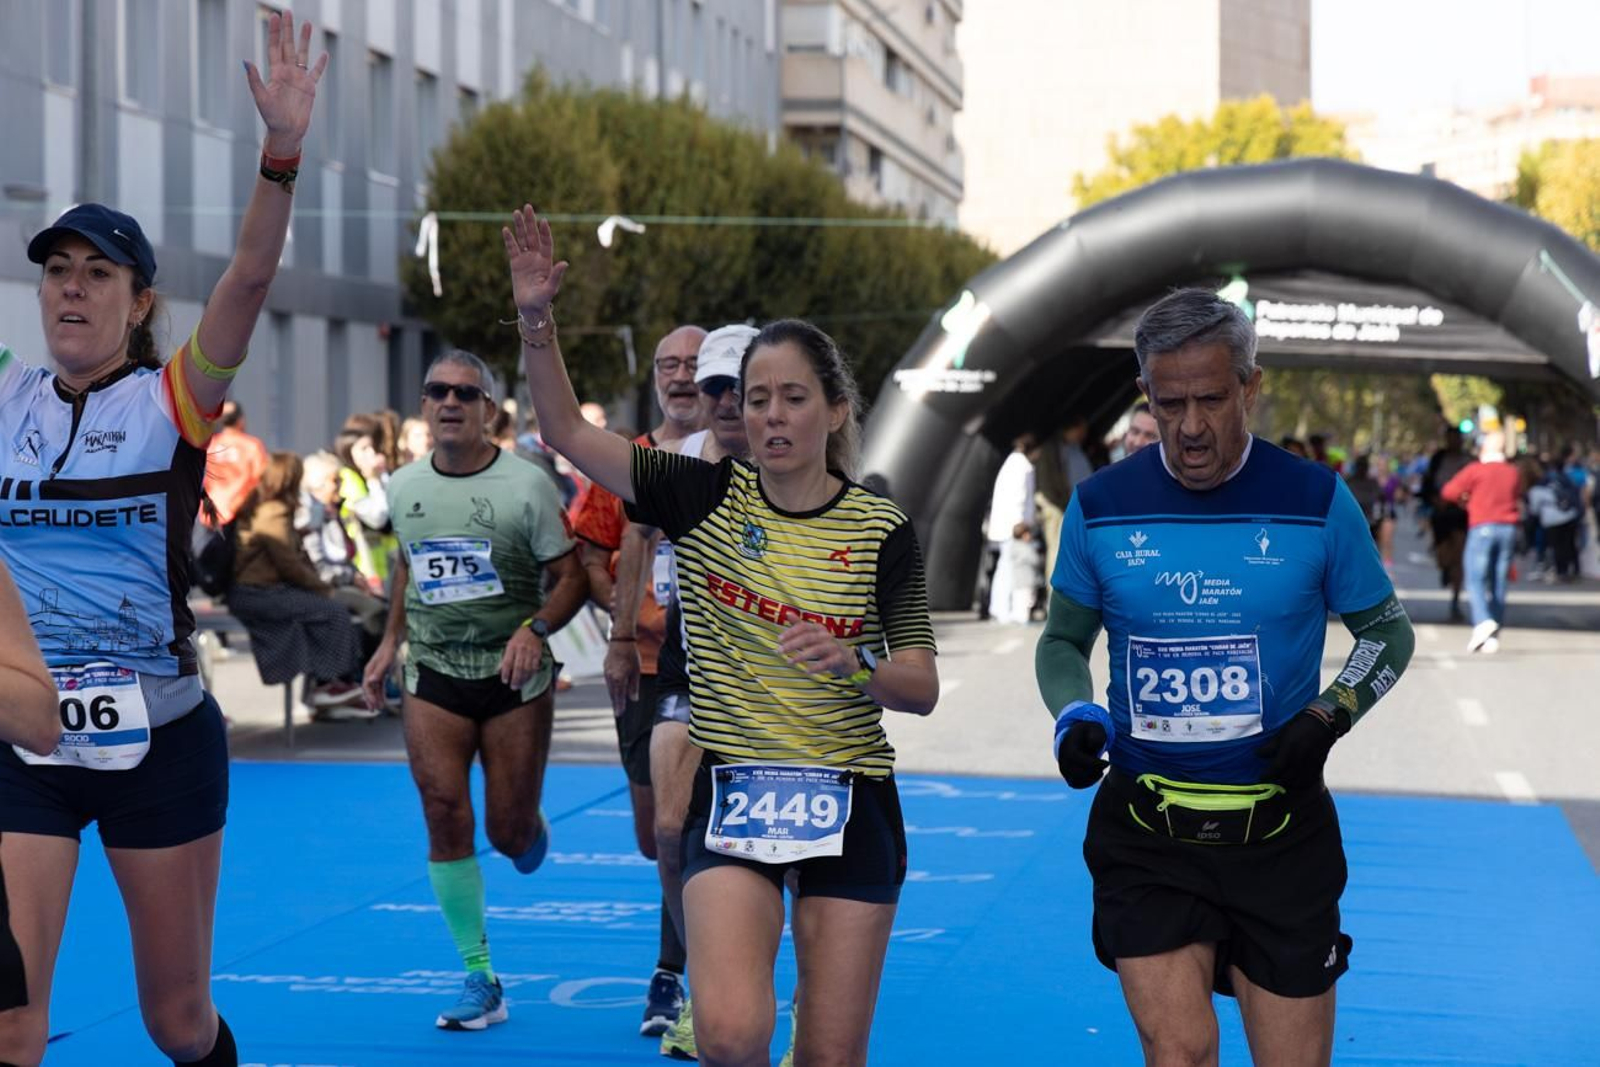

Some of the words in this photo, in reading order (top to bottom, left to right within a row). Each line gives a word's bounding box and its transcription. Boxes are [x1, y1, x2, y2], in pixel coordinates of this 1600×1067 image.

[1115, 550, 1133, 559] CAJA
[1135, 549, 1162, 557] RURAL
[428, 556, 480, 579] 575
[1204, 579, 1231, 587] MEDIA
[1201, 586, 1243, 596] MARATÓN
[1136, 666, 1250, 703] 2308
[1181, 704, 1201, 712] JOSE
[722, 791, 838, 828] 2449
[768, 827, 789, 835] MAR
